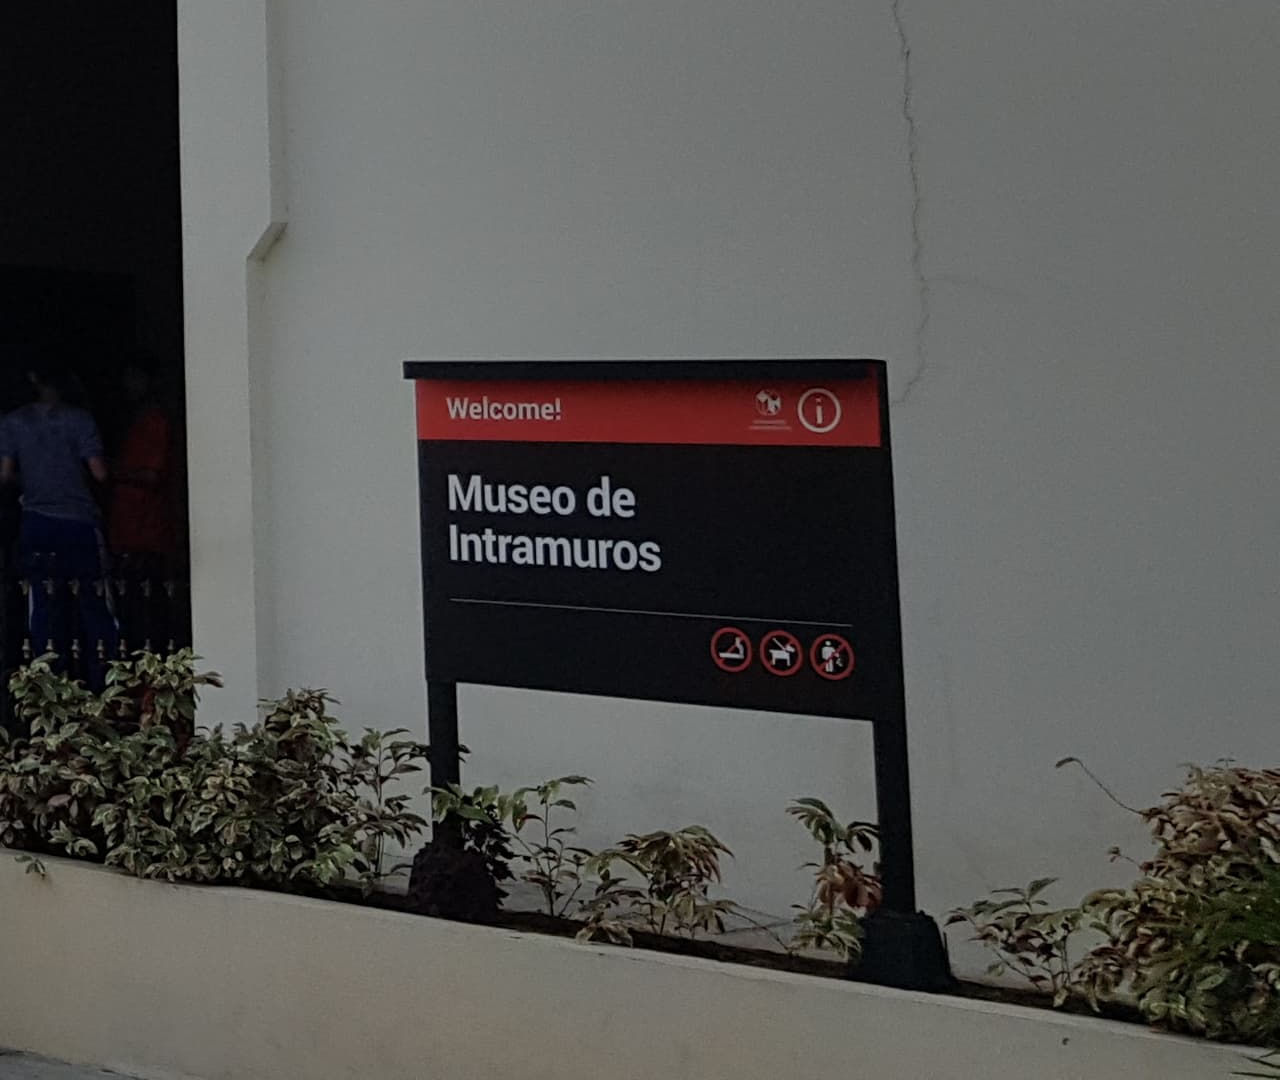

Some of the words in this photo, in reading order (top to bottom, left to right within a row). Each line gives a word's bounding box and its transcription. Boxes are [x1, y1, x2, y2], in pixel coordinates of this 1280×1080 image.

[446, 396, 561, 420] Welcome!
[448, 474, 576, 515] Museo
[587, 476, 636, 518] de
[449, 525, 662, 572] Intramuros
